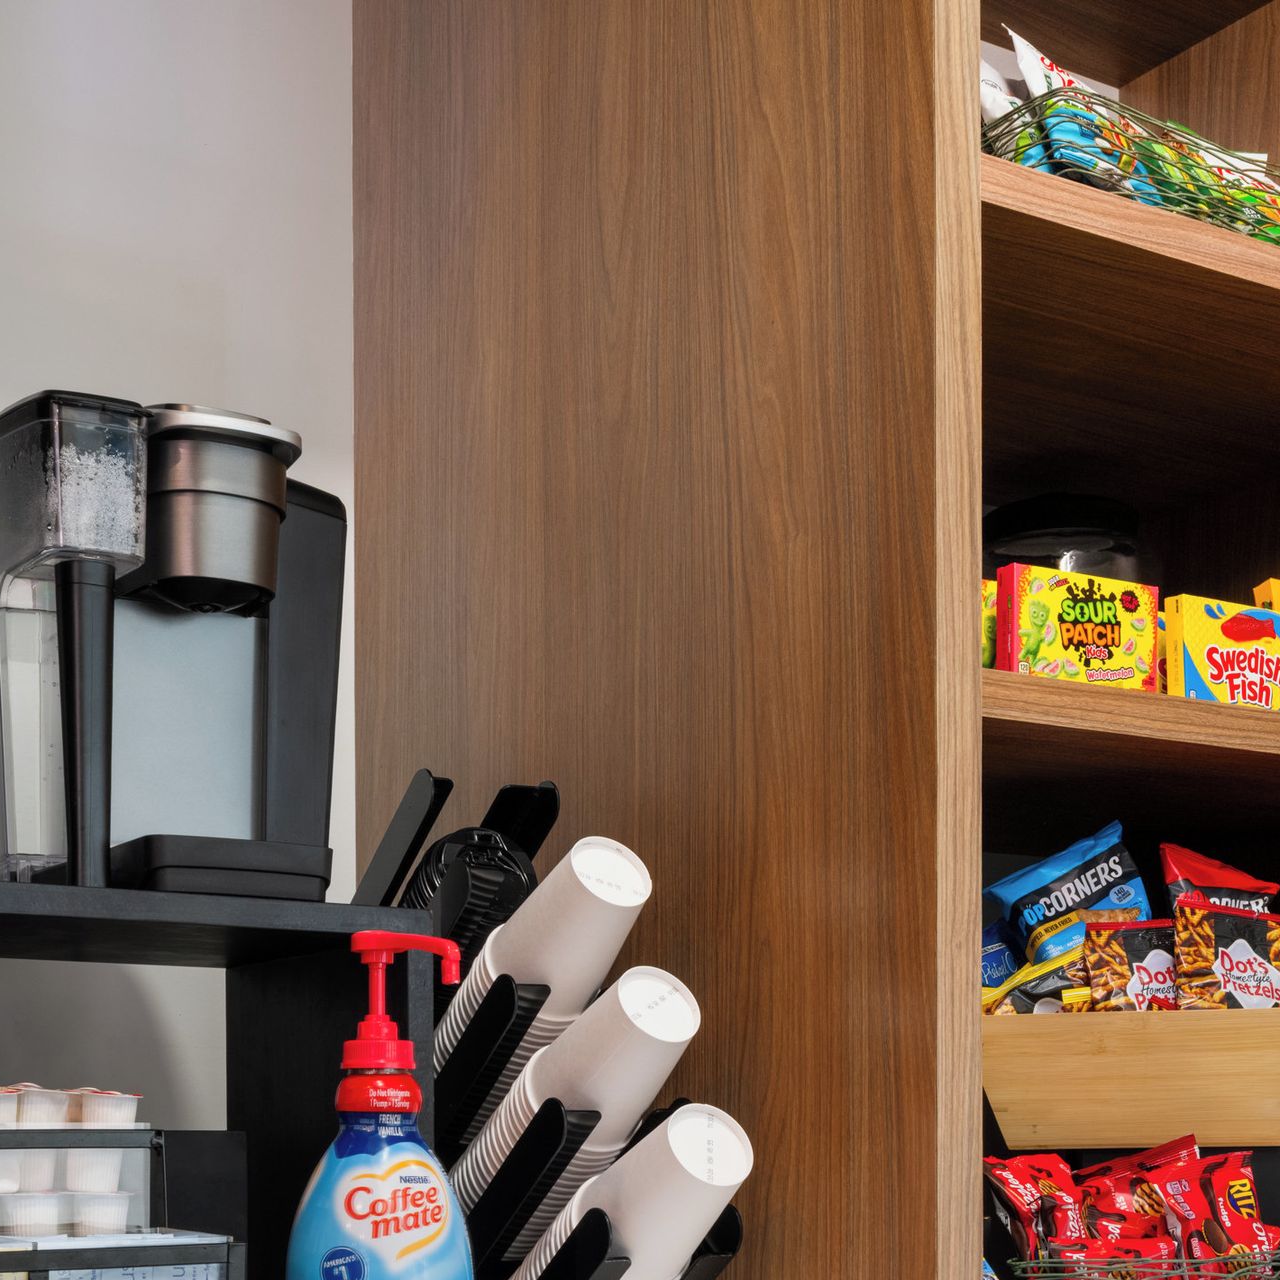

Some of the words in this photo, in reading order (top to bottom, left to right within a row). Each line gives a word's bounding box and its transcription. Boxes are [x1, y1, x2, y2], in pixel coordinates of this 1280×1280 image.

[1061, 599, 1117, 624] SOUR
[1060, 622, 1120, 648] PATCH
[1085, 645, 1109, 660] Kids
[1086, 667, 1135, 682] Watermelon
[1225, 672, 1272, 709] Fish
[1219, 949, 1269, 975] Dot's
[1135, 963, 1176, 986] Dot
[1225, 970, 1272, 987] Homestyle
[373, 1098, 388, 1109] Pump
[394, 1098, 410, 1109] Serving
[379, 1114, 401, 1124] FRENCH
[378, 1126, 403, 1137] VANILLA
[344, 1186, 438, 1221] Coffee
[1228, 1178, 1257, 1220] RITZ
[370, 1204, 444, 1239] mate
[1218, 1197, 1232, 1227] fudge
[333, 1265, 348, 1280] #1
